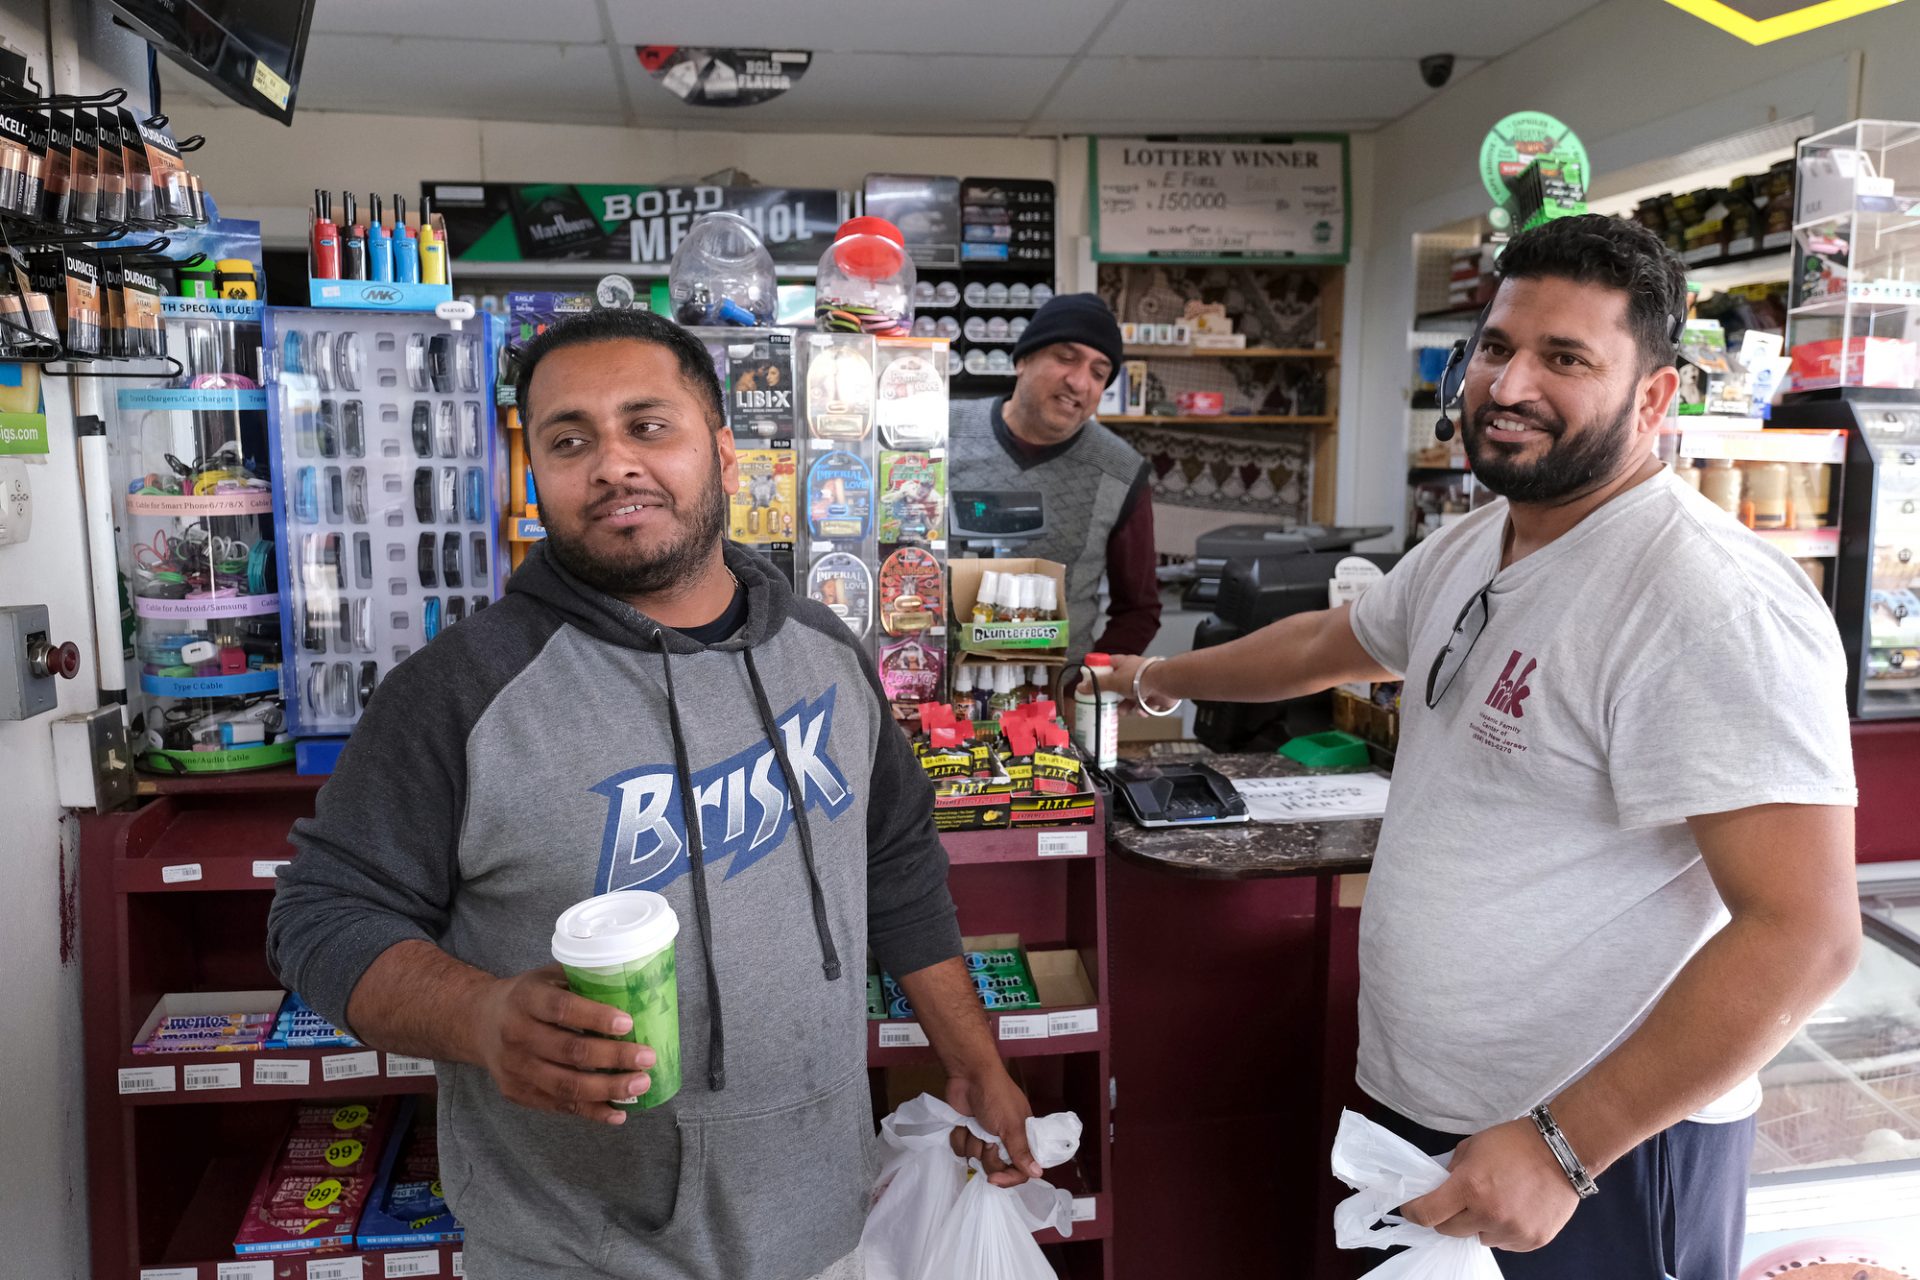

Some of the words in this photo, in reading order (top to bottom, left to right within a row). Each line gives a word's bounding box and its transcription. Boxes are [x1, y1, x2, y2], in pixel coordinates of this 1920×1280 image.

[746, 60, 783, 75] BOLD
[737, 75, 791, 89] FLAVOR
[139, 124, 178, 152] DURACELL
[1123, 147, 1224, 168] LOTTERY
[1233, 149, 1319, 168] WINNER
[602, 186, 724, 222] BOLD
[529, 214, 595, 241] Marlboro
[67, 257, 99, 279] DURACELL
[124, 269, 158, 290] DURACELL
[179, 303, 222, 314] SPECIAL
[225, 304, 255, 315] BLUE!
[0, 423, 39, 443] igs.com
[844, 480, 867, 489] LOVE
[816, 569, 864, 583] IMPERIAL
[844, 582, 867, 590] LOVE
[174, 602, 248, 613] Android/Samsung
[173, 683, 190, 692] Type
[200, 682, 223, 690] Cable
[1482, 721, 1499, 733] Center
[1499, 721, 1521, 735] Family
[1488, 733, 1501, 742] New
[1502, 739, 1528, 752] Jersey
[226, 754, 250, 762] Cable
[951, 782, 986, 795] F.I.T.T.
[1038, 798, 1072, 810] F.I.T.T.
[965, 952, 1016, 971] Orbit
[972, 974, 1022, 990] Orbit
[978, 990, 1029, 1008] Orbit
[164, 1015, 232, 1030] mentos
[306, 1186, 340, 1202] 99¢
[297, 1240, 306, 1249] Fig
